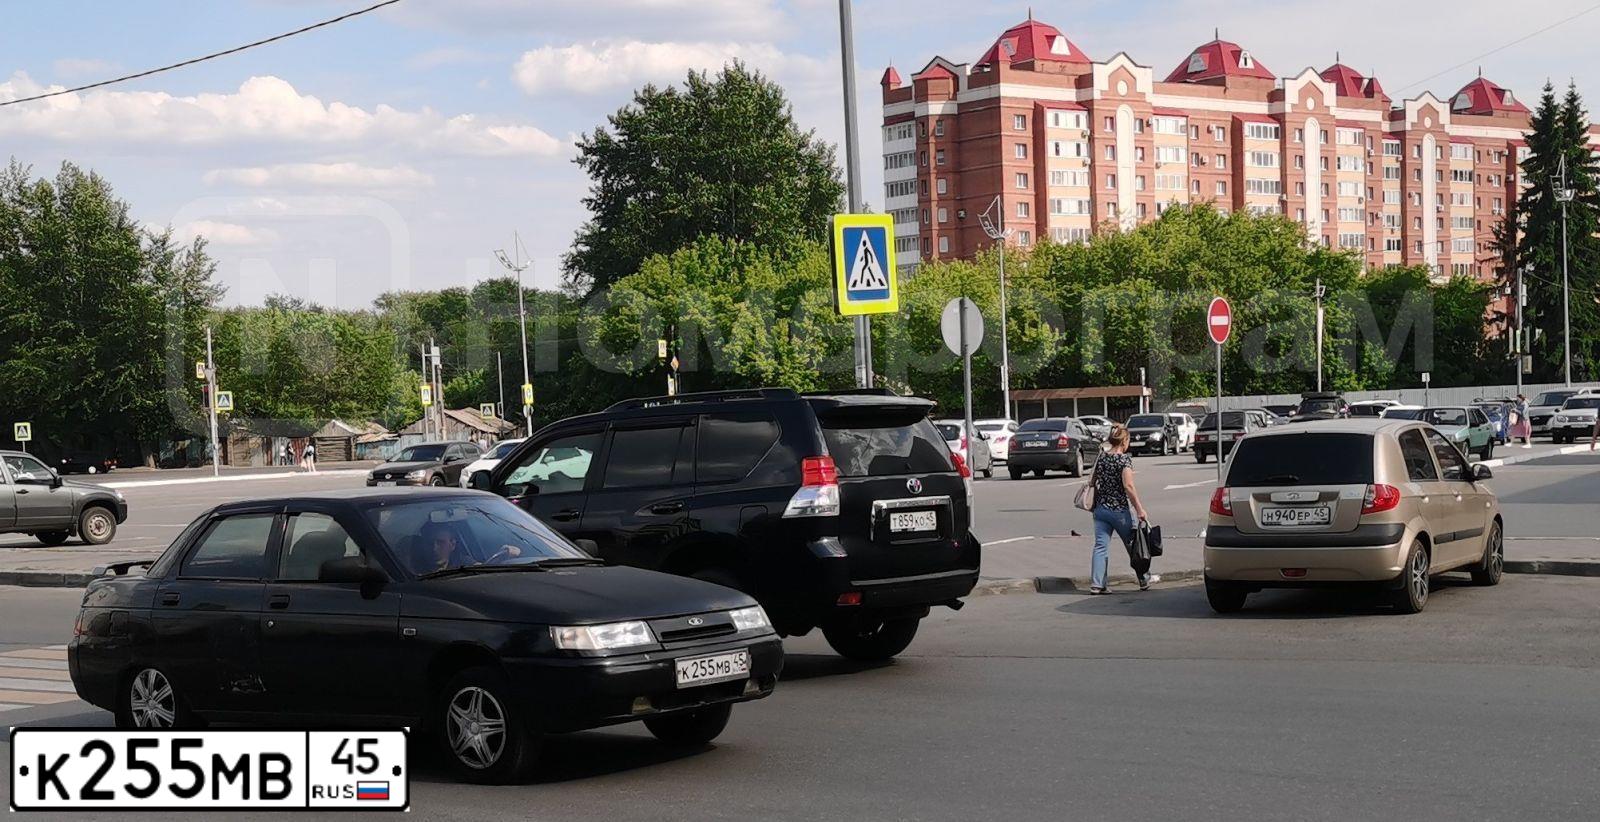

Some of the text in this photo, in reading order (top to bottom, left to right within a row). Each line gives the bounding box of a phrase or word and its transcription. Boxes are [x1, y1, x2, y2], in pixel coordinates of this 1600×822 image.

[1266, 508, 1325, 521] Н940ЕР 45
[682, 659, 731, 679] К255МВ
[733, 653, 747, 667] 45
